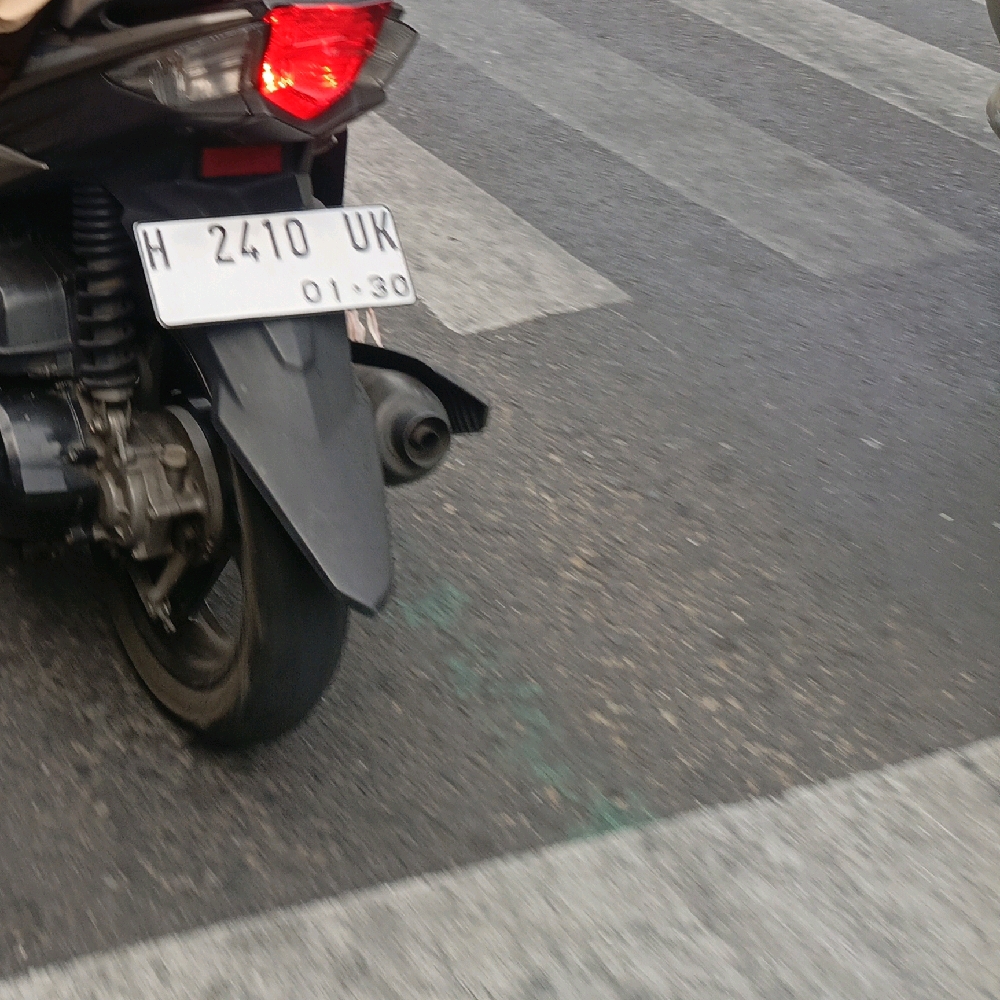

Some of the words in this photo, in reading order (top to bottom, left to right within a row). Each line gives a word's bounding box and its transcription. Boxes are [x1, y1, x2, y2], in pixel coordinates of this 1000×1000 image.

[142, 227, 171, 270] H
[207, 217, 309, 264] 2410
[342, 210, 399, 252] UK
